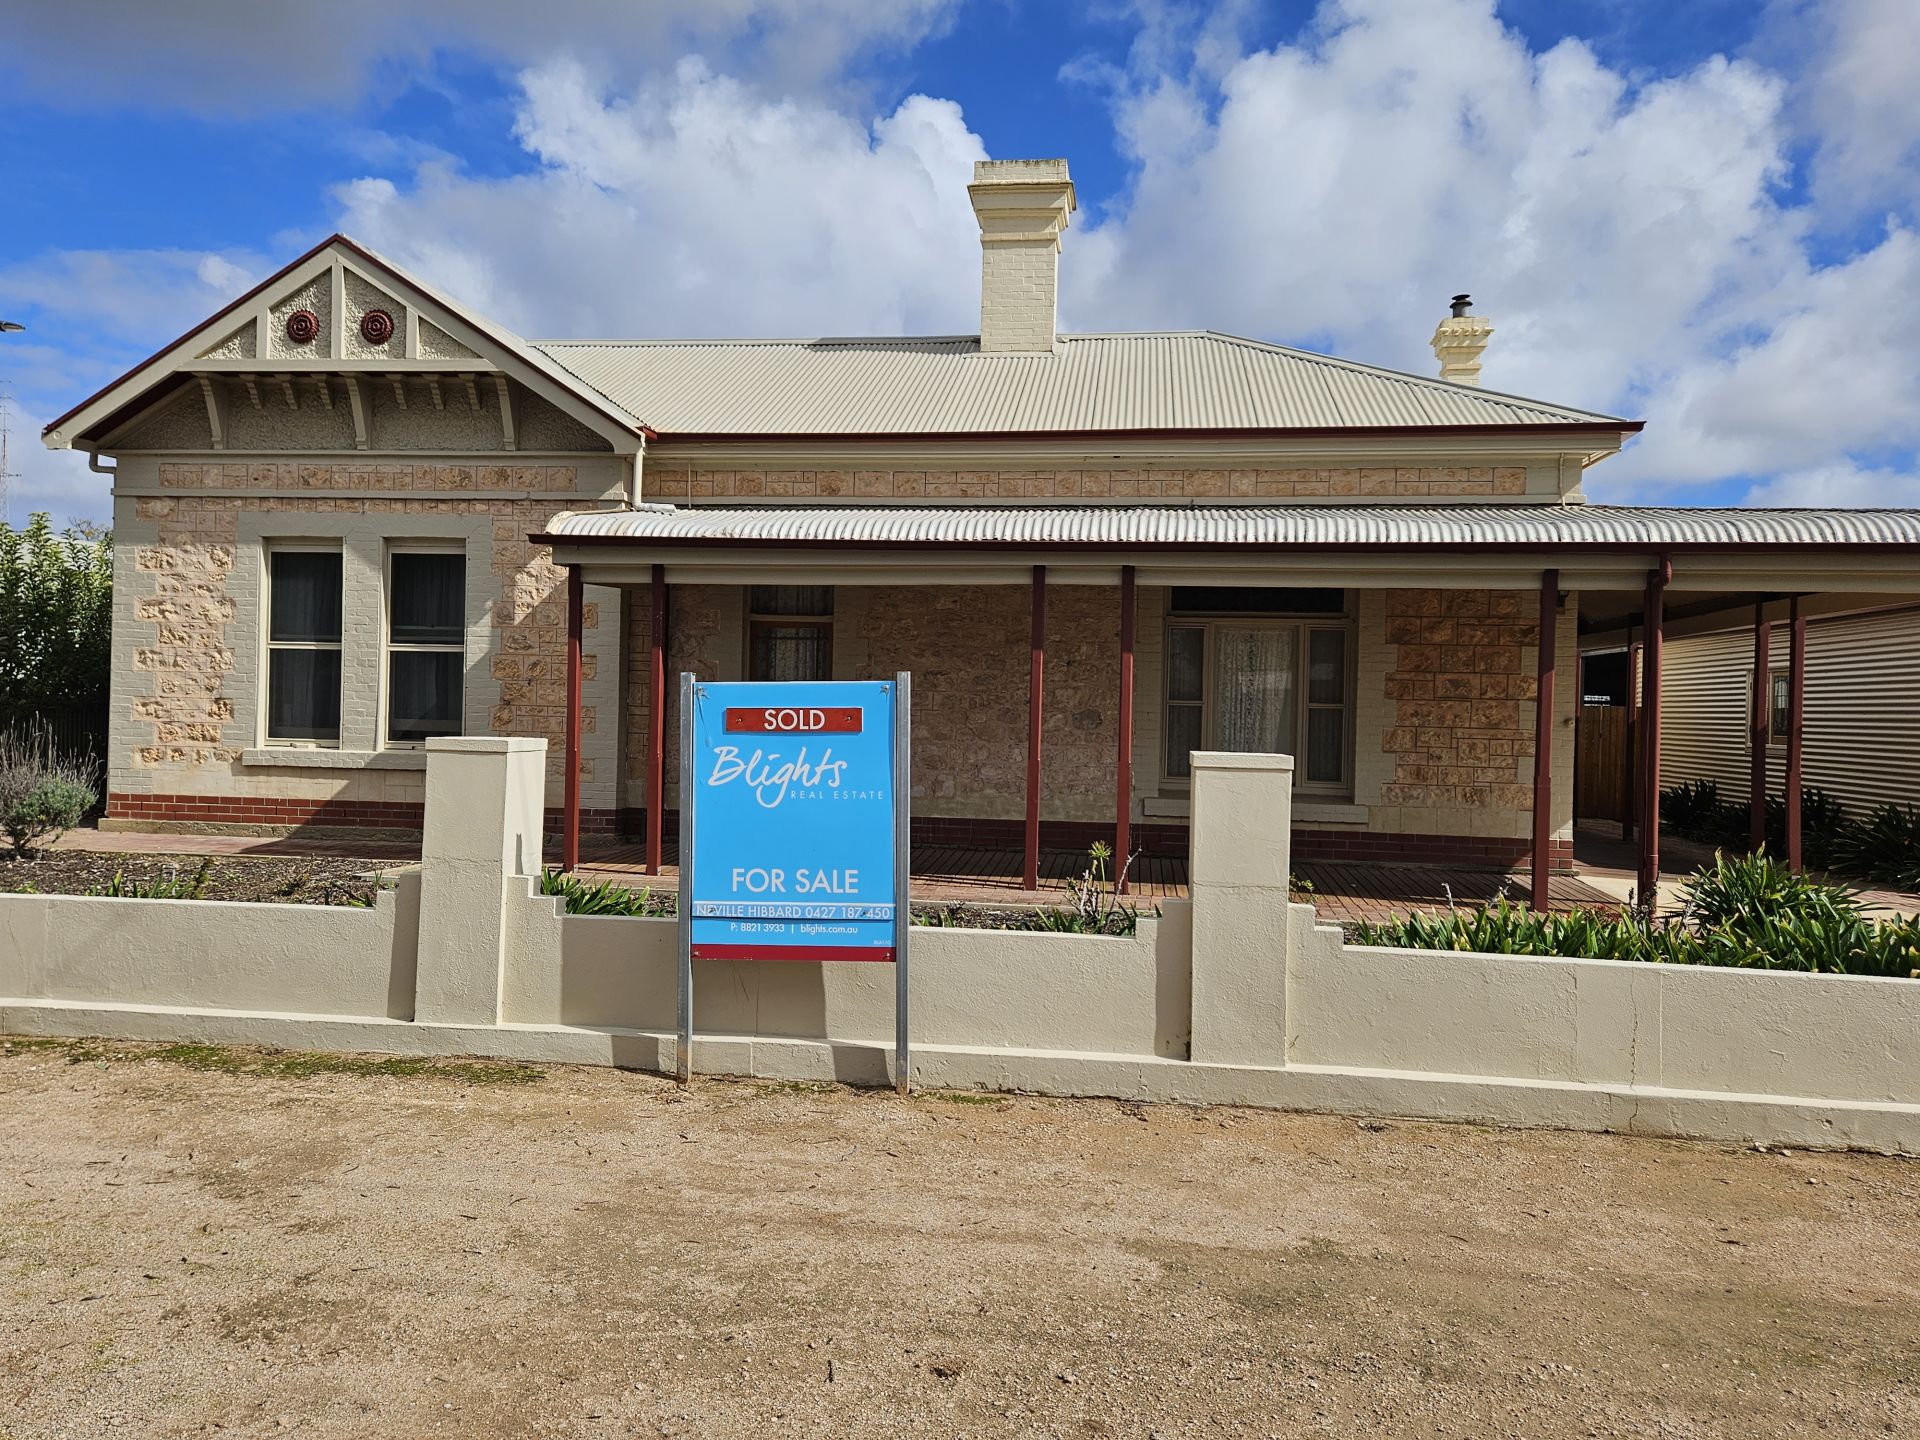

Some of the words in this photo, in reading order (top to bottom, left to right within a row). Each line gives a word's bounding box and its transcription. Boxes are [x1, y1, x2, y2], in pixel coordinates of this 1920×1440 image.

[763, 709, 826, 730] SOLD
[708, 746, 848, 808] Blights
[791, 790, 824, 800] REAL
[833, 791, 884, 800] ESTATE
[732, 868, 786, 893] FOR
[795, 869, 859, 894] SALE
[696, 904, 744, 917] NEVILLE
[748, 905, 801, 918] HIBBARD
[805, 906, 836, 918] 0427
[865, 907, 890, 919] 450
[730, 923, 738, 932] P:
[740, 923, 761, 933] 8821
[763, 923, 785, 933] 3933
[800, 924, 858, 935] blights.com.au
